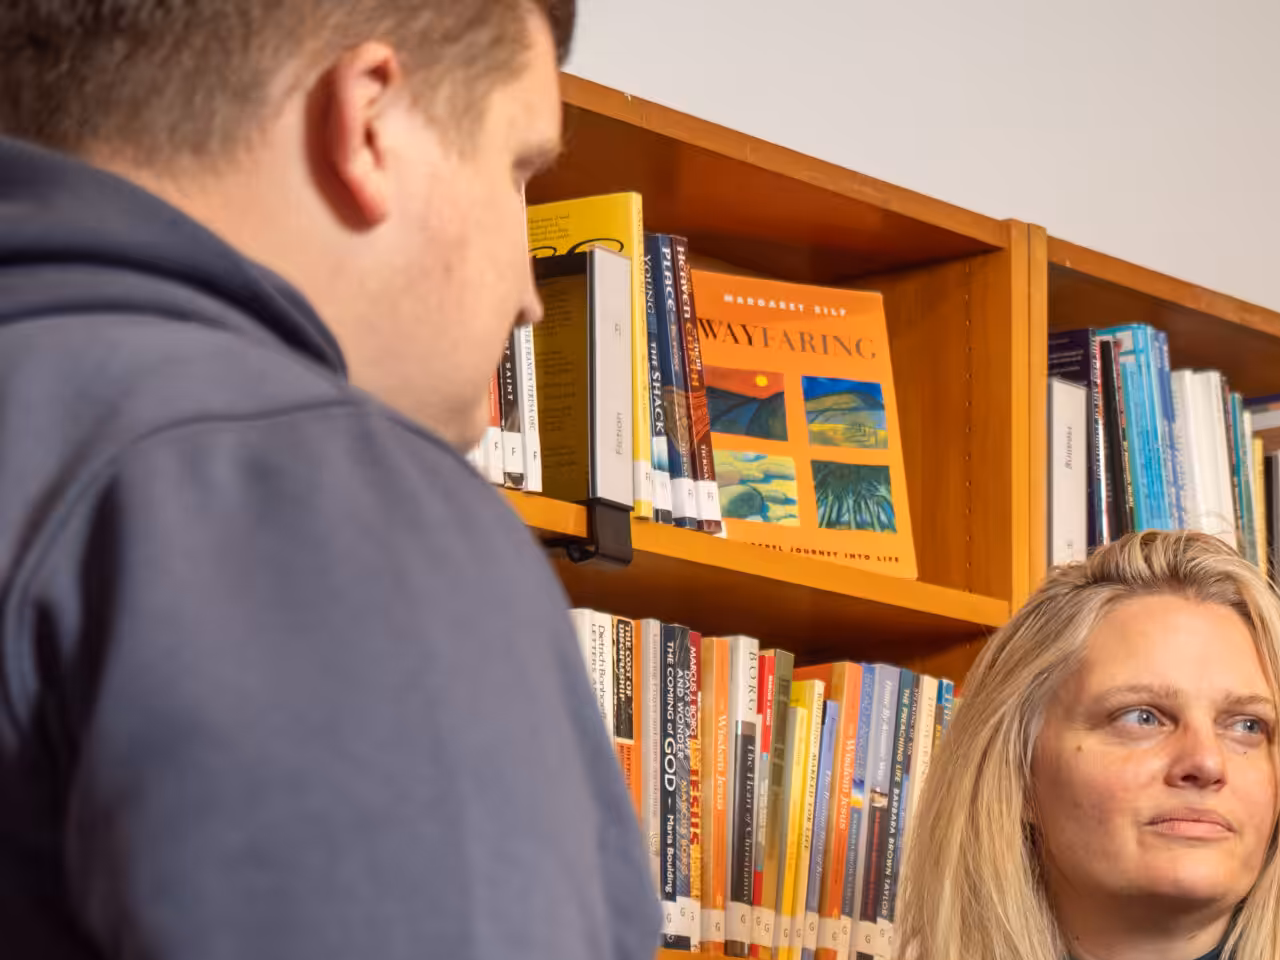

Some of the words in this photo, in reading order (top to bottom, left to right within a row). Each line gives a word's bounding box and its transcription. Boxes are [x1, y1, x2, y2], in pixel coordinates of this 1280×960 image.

[644, 255, 655, 314] YOUNG
[662, 247, 675, 312] PLACE
[723, 293, 805, 313] MARGARET
[650, 341, 658, 368] THE
[697, 317, 877, 361] WAYFARING
[505, 361, 514, 401] SAINT
[525, 346, 534, 381] FRANCES
[527, 382, 535, 414] TERESA
[651, 370, 665, 434] SHACK
[790, 547, 838, 559] JOURNEY
[844, 552, 871, 561] INTO
[876, 555, 900, 563] LIFE
[598, 625, 606, 667] Dietrich
[625, 623, 633, 650] THE
[666, 641, 674, 664] THE
[618, 623, 626, 702] DISCIPLESHIP
[625, 651, 633, 680] COST
[689, 645, 698, 692] MARCUS
[748, 651, 757, 712] BORG
[625, 680, 633, 697] OF
[666, 668, 674, 721] COMING
[676, 668, 684, 697] AND
[903, 688, 911, 705] THE
[666, 723, 674, 735] of
[676, 701, 685, 759] WONDER
[684, 706, 691, 724] OF
[689, 704, 698, 736] BORG
[896, 706, 909, 761] PREACHING
[717, 714, 727, 772] Wisdom
[746, 745, 755, 769] The
[664, 737, 676, 792] GOD
[843, 739, 856, 791] Wisdom
[894, 763, 902, 783] LIFE
[689, 768, 700, 847] JESUS
[717, 774, 727, 810] Jesus
[746, 773, 754, 811] Heart
[888, 788, 900, 834] BARBARA
[666, 815, 675, 845] Maria
[839, 794, 849, 830] Jesus
[665, 847, 675, 895] Boulding
[885, 838, 896, 876] BROWN
[881, 878, 891, 916] TAYLOR
